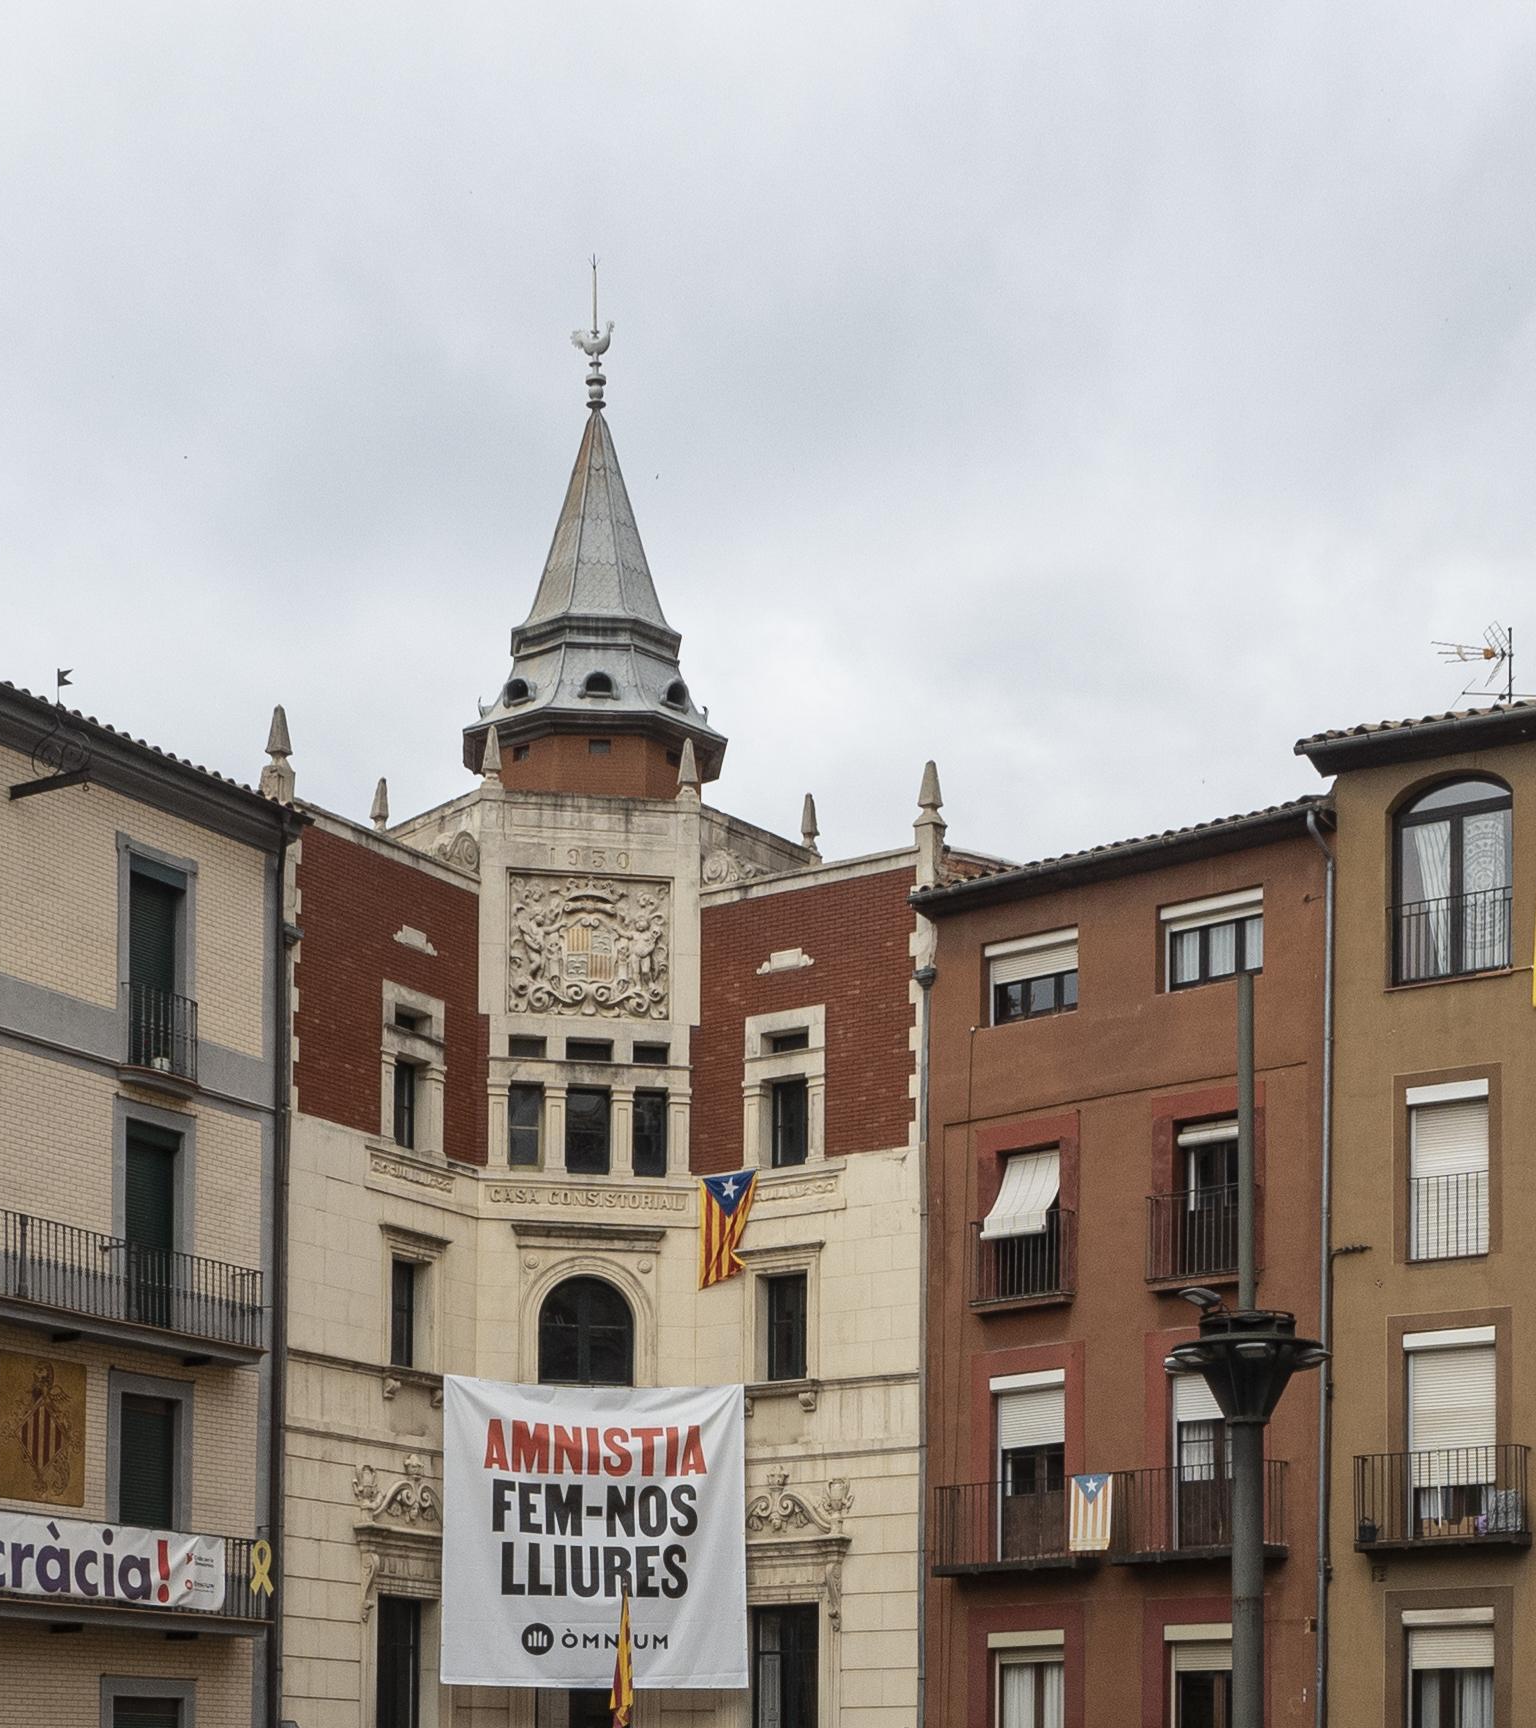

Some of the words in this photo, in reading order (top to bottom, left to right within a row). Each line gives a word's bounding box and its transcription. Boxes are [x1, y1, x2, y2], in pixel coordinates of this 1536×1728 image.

[490, 1188, 539, 1205] CASA
[548, 1190, 686, 1211] CONSISTORIAL
[484, 1419, 707, 1477] AMNISTIA
[492, 1479, 698, 1537] FEM-NOS
[501, 1543, 688, 1599] LLIURES
[562, 1628, 668, 1650] ÒMNUM
